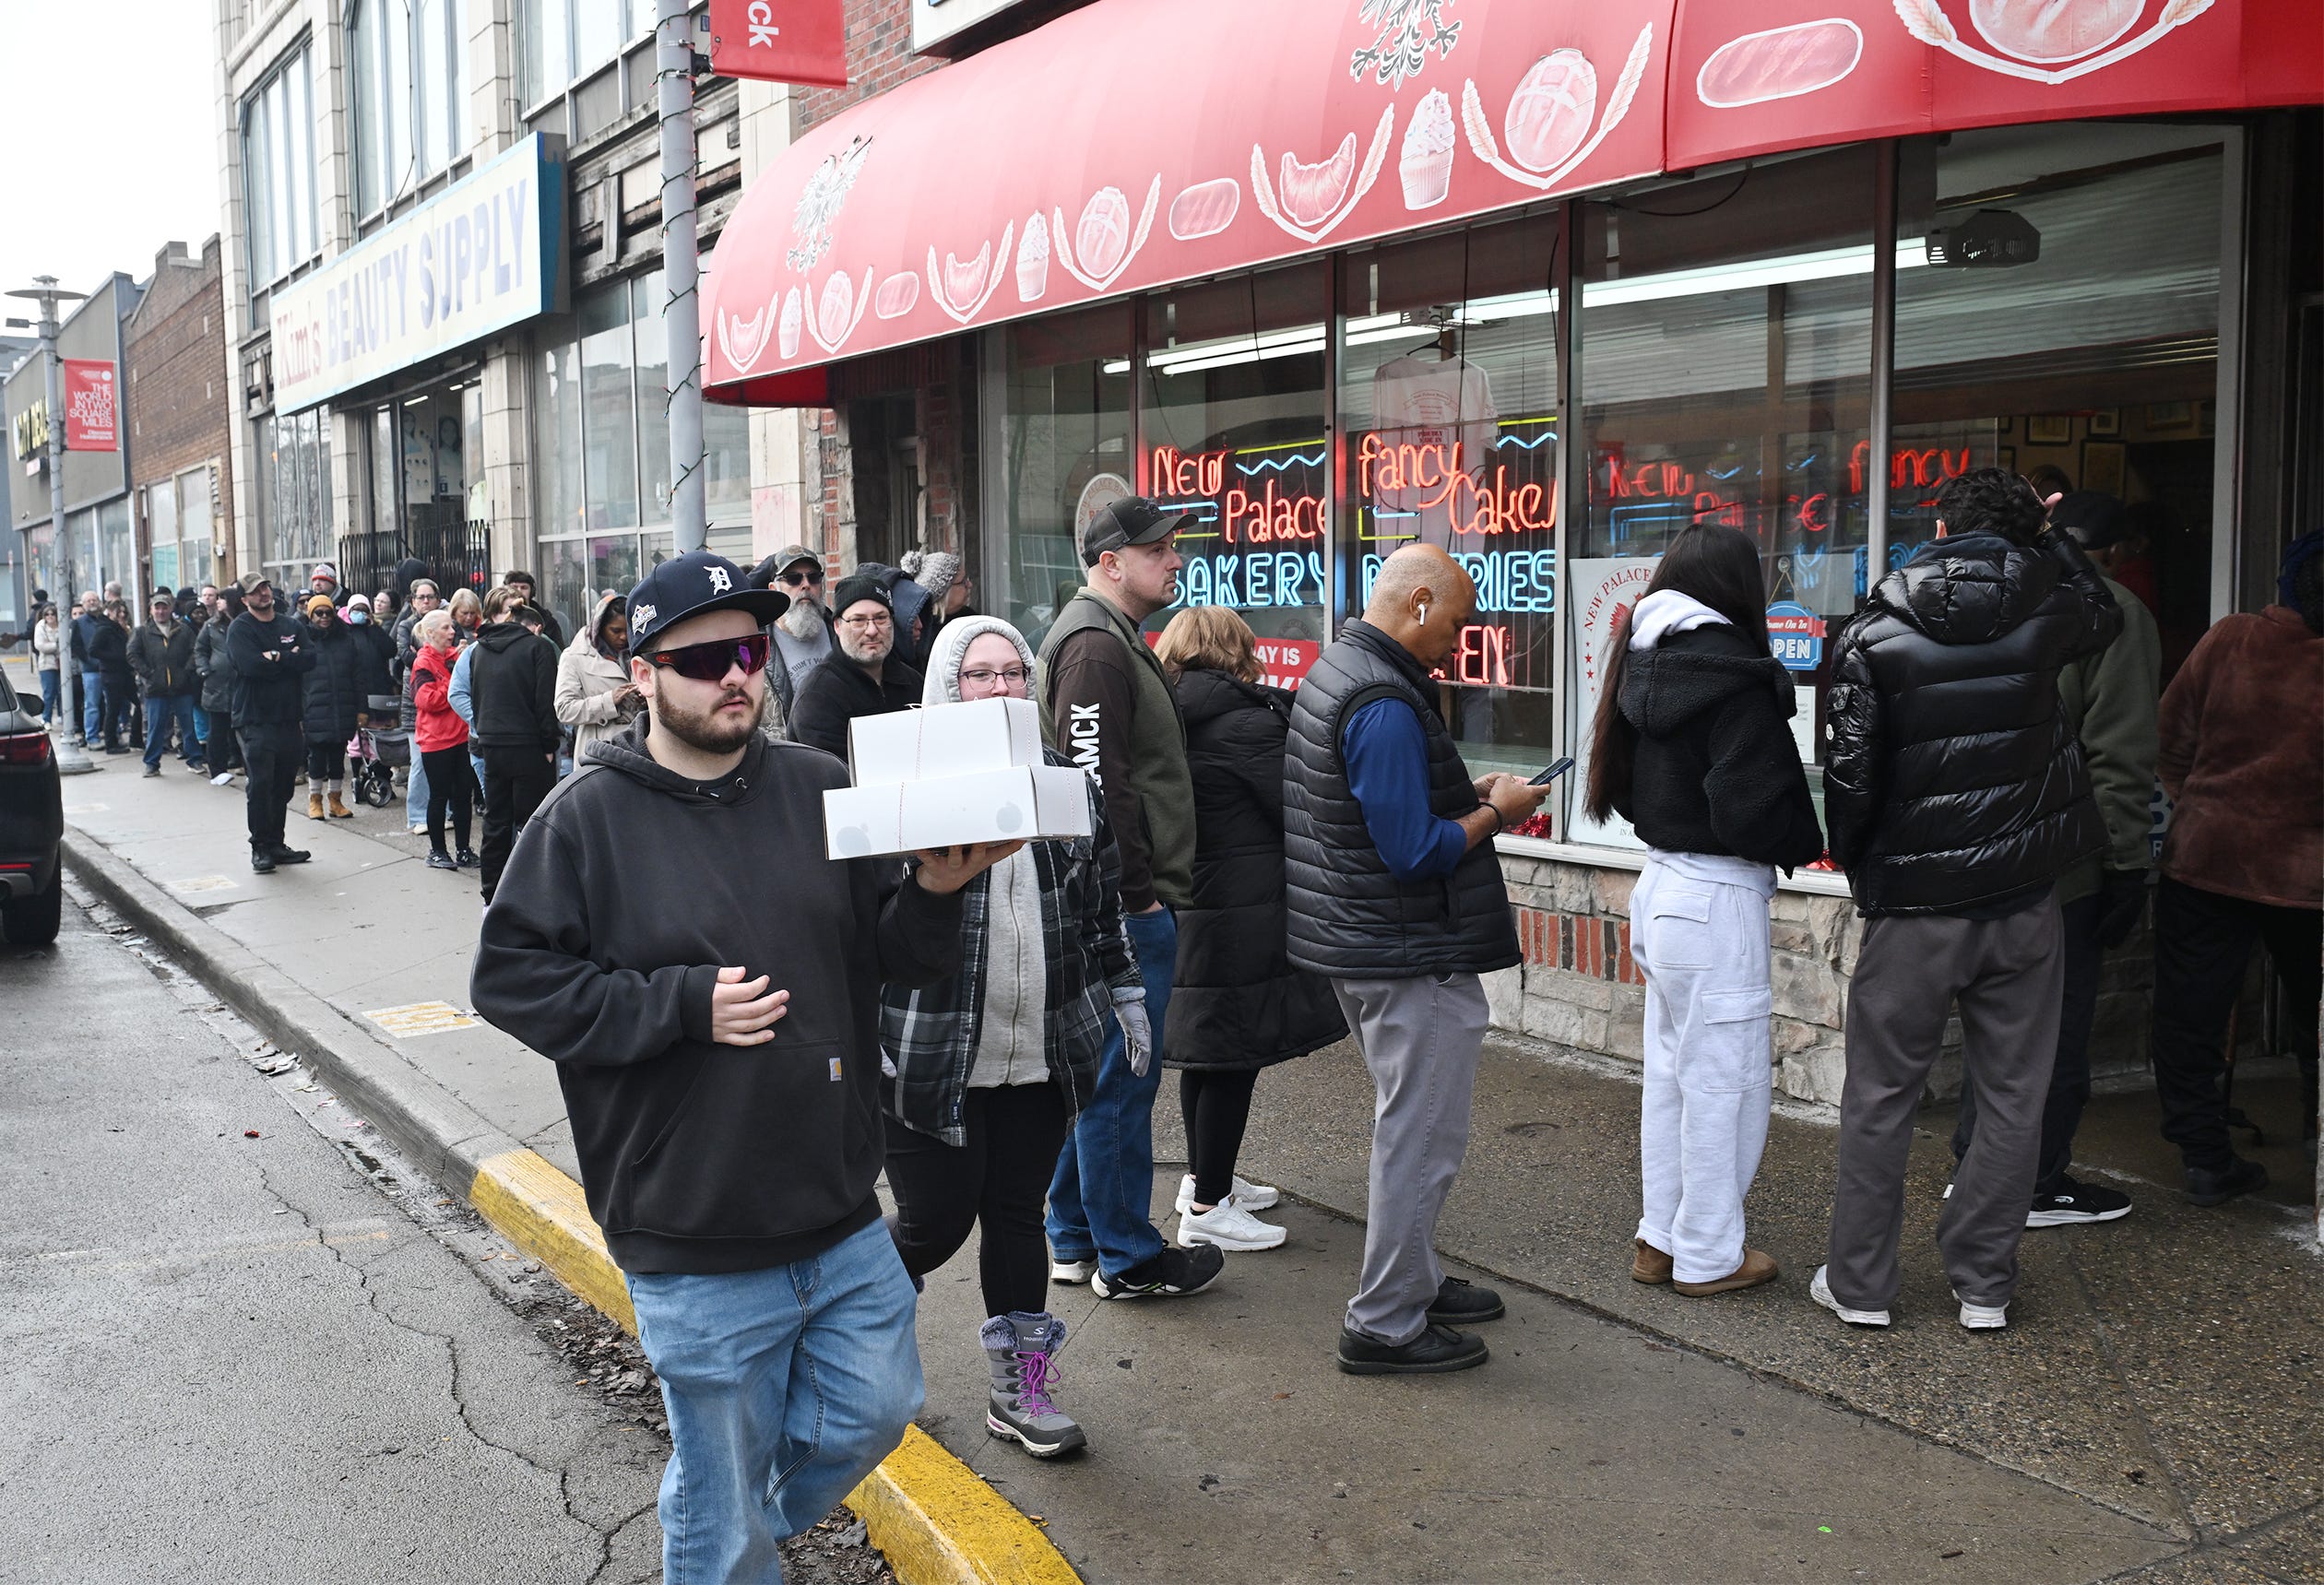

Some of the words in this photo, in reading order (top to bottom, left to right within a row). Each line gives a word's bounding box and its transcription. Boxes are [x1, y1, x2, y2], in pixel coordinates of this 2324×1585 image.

[748, 0, 779, 48] ck
[277, 301, 321, 390] Kim's
[326, 242, 409, 368] BEAUTY
[419, 177, 528, 330] SUPPLY
[74, 391, 113, 402] WORLD
[91, 383, 112, 393] THE
[69, 408, 113, 419] SQUARE
[82, 418, 113, 428] MILES
[703, 565, 733, 596] D
[1584, 592, 1604, 632] NEW
[1602, 568, 1652, 596] PALACE
[1784, 619, 1797, 630] On
[1797, 619, 1808, 630] In
[1282, 646, 1300, 666] IS
[1769, 638, 1811, 659] PEN
[1070, 703, 1104, 796] AMCK
